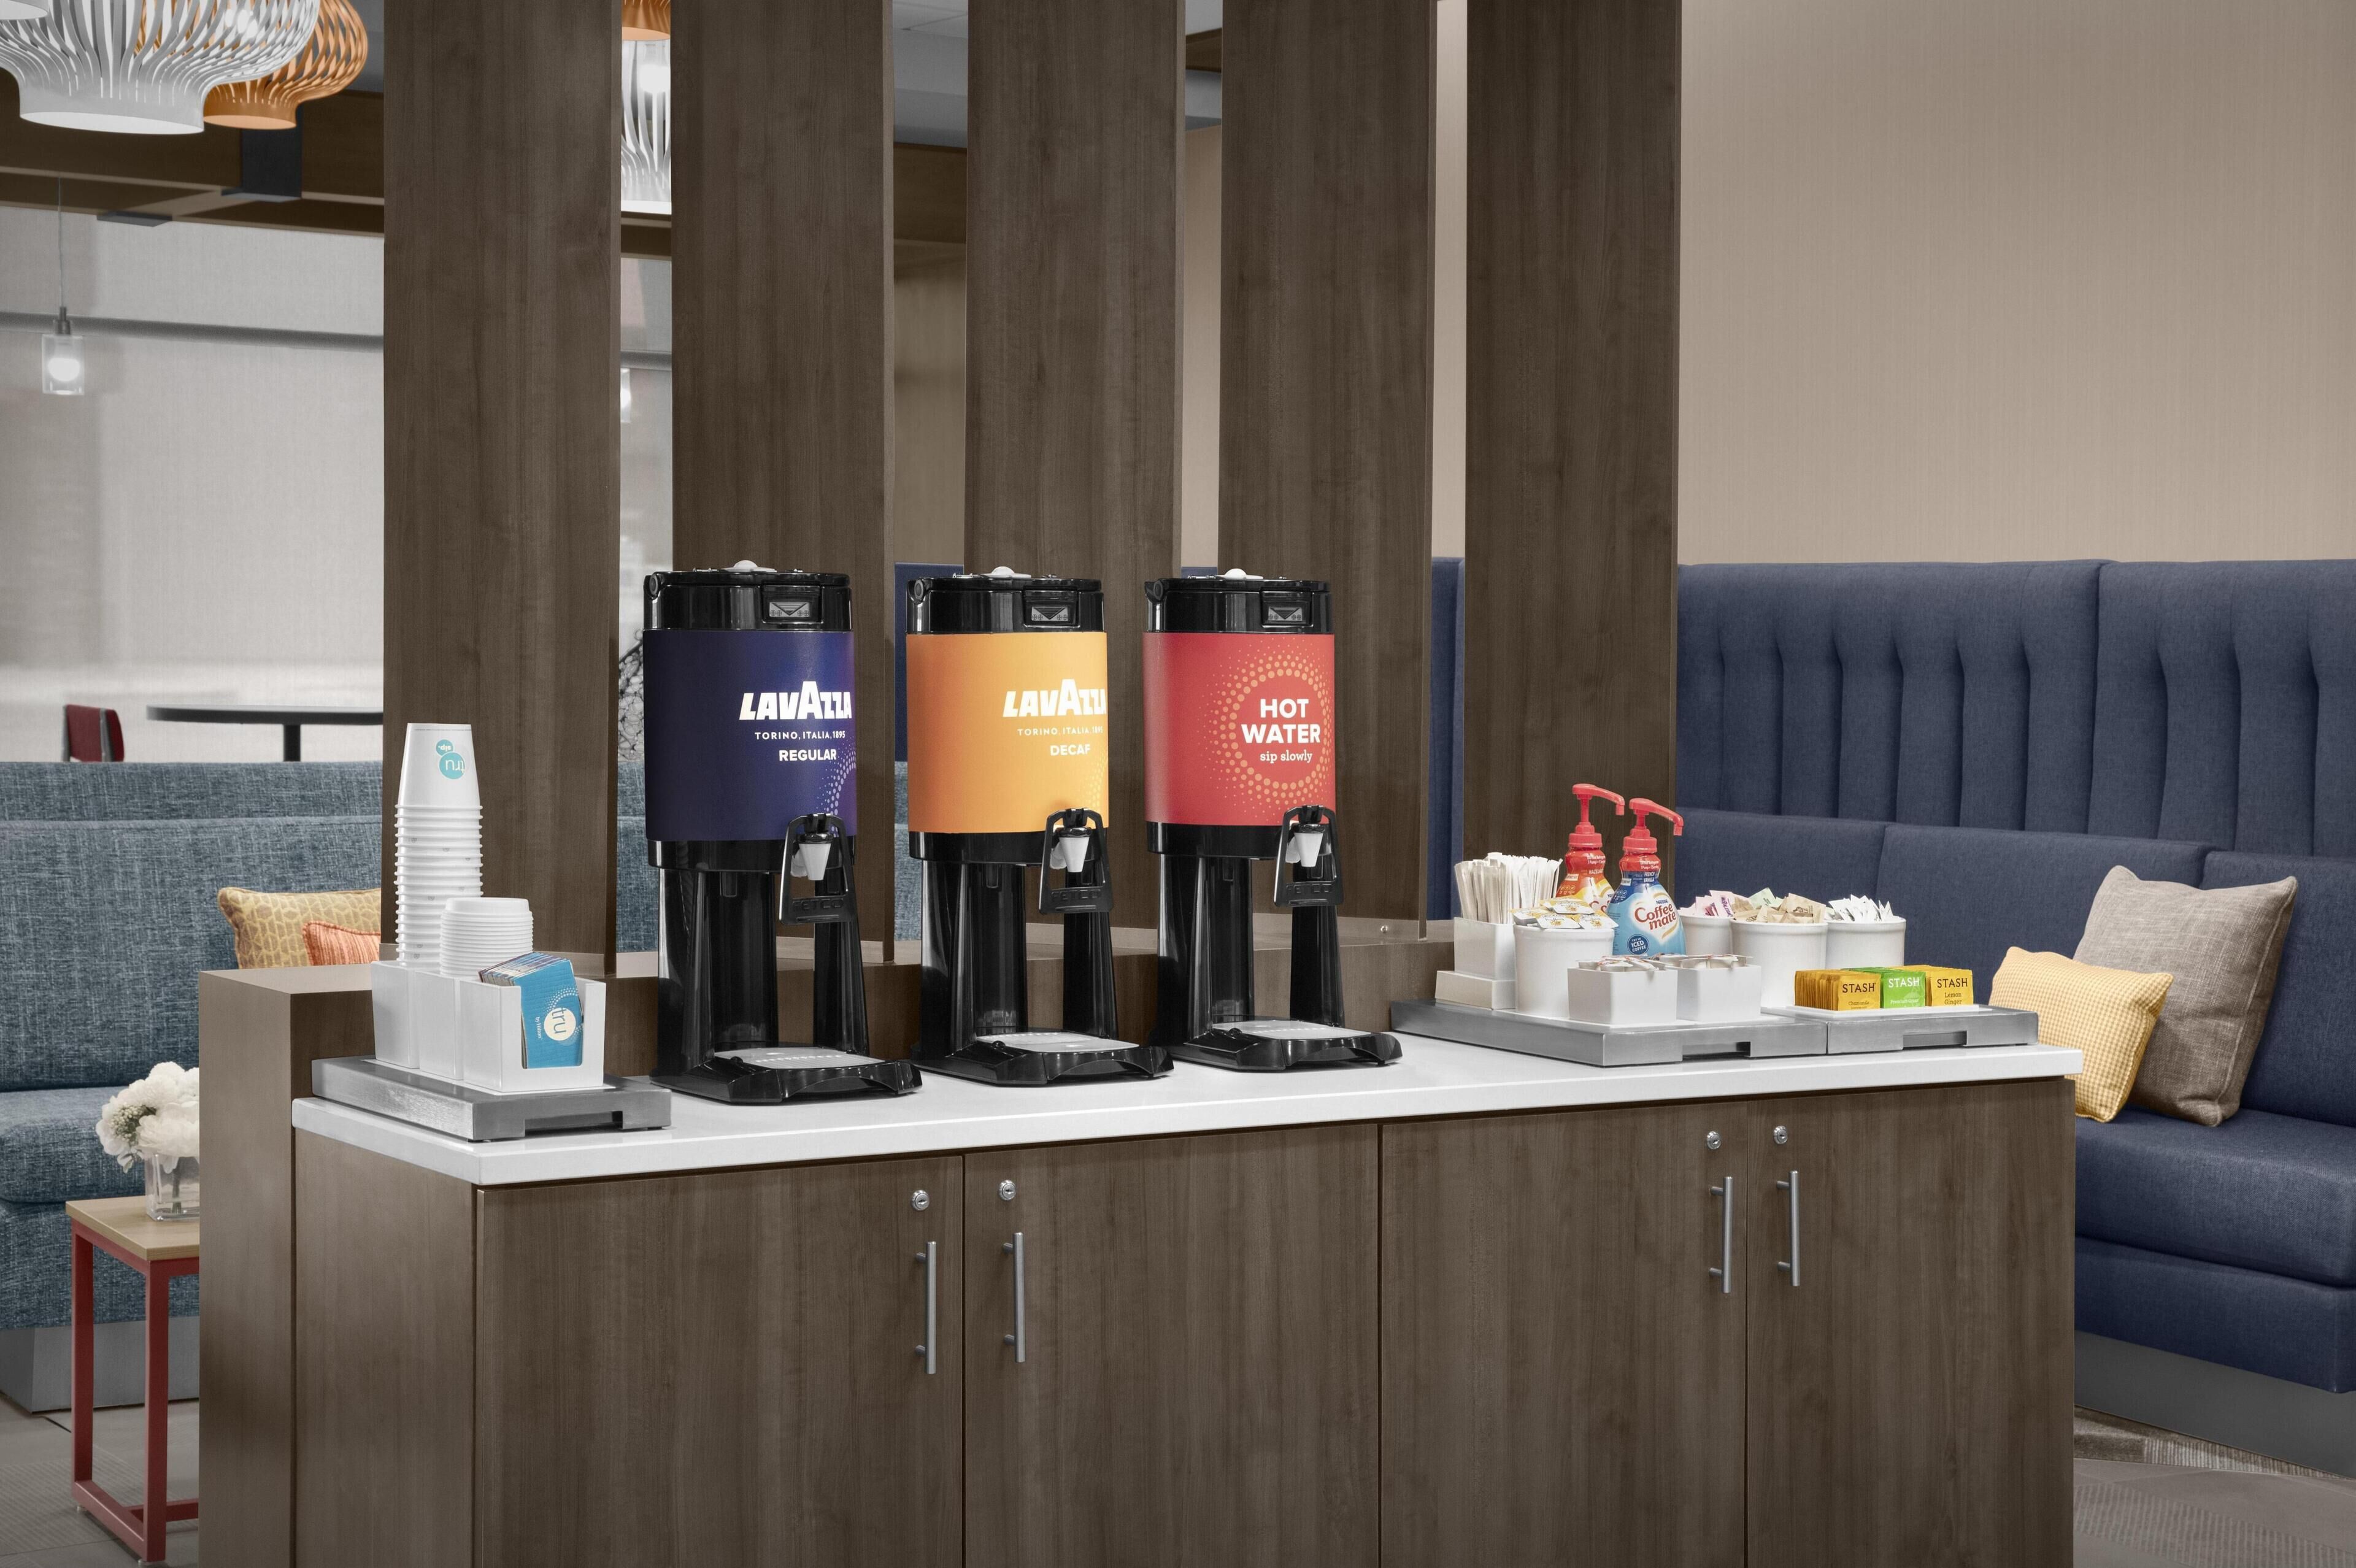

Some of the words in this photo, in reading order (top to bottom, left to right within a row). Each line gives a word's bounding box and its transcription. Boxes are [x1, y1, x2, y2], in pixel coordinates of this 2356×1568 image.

[739, 680, 853, 721] LAVAZZA
[1260, 698, 1309, 718] HOT
[755, 731, 801, 740] TORINO,
[1241, 724, 1321, 744] WATER
[779, 749, 837, 761] REGULAR
[1050, 744, 1090, 756] DECAF
[1260, 751, 1277, 764] sip
[1280, 749, 1312, 763] slowly
[445, 759, 465, 774] tru
[1634, 904, 1674, 923] Coffee
[1649, 912, 1677, 930] mate
[1842, 983, 1876, 993] STASH
[1888, 977, 1920, 988] STASH
[1937, 978, 1968, 988] STASH
[552, 1007, 567, 1034] tru
